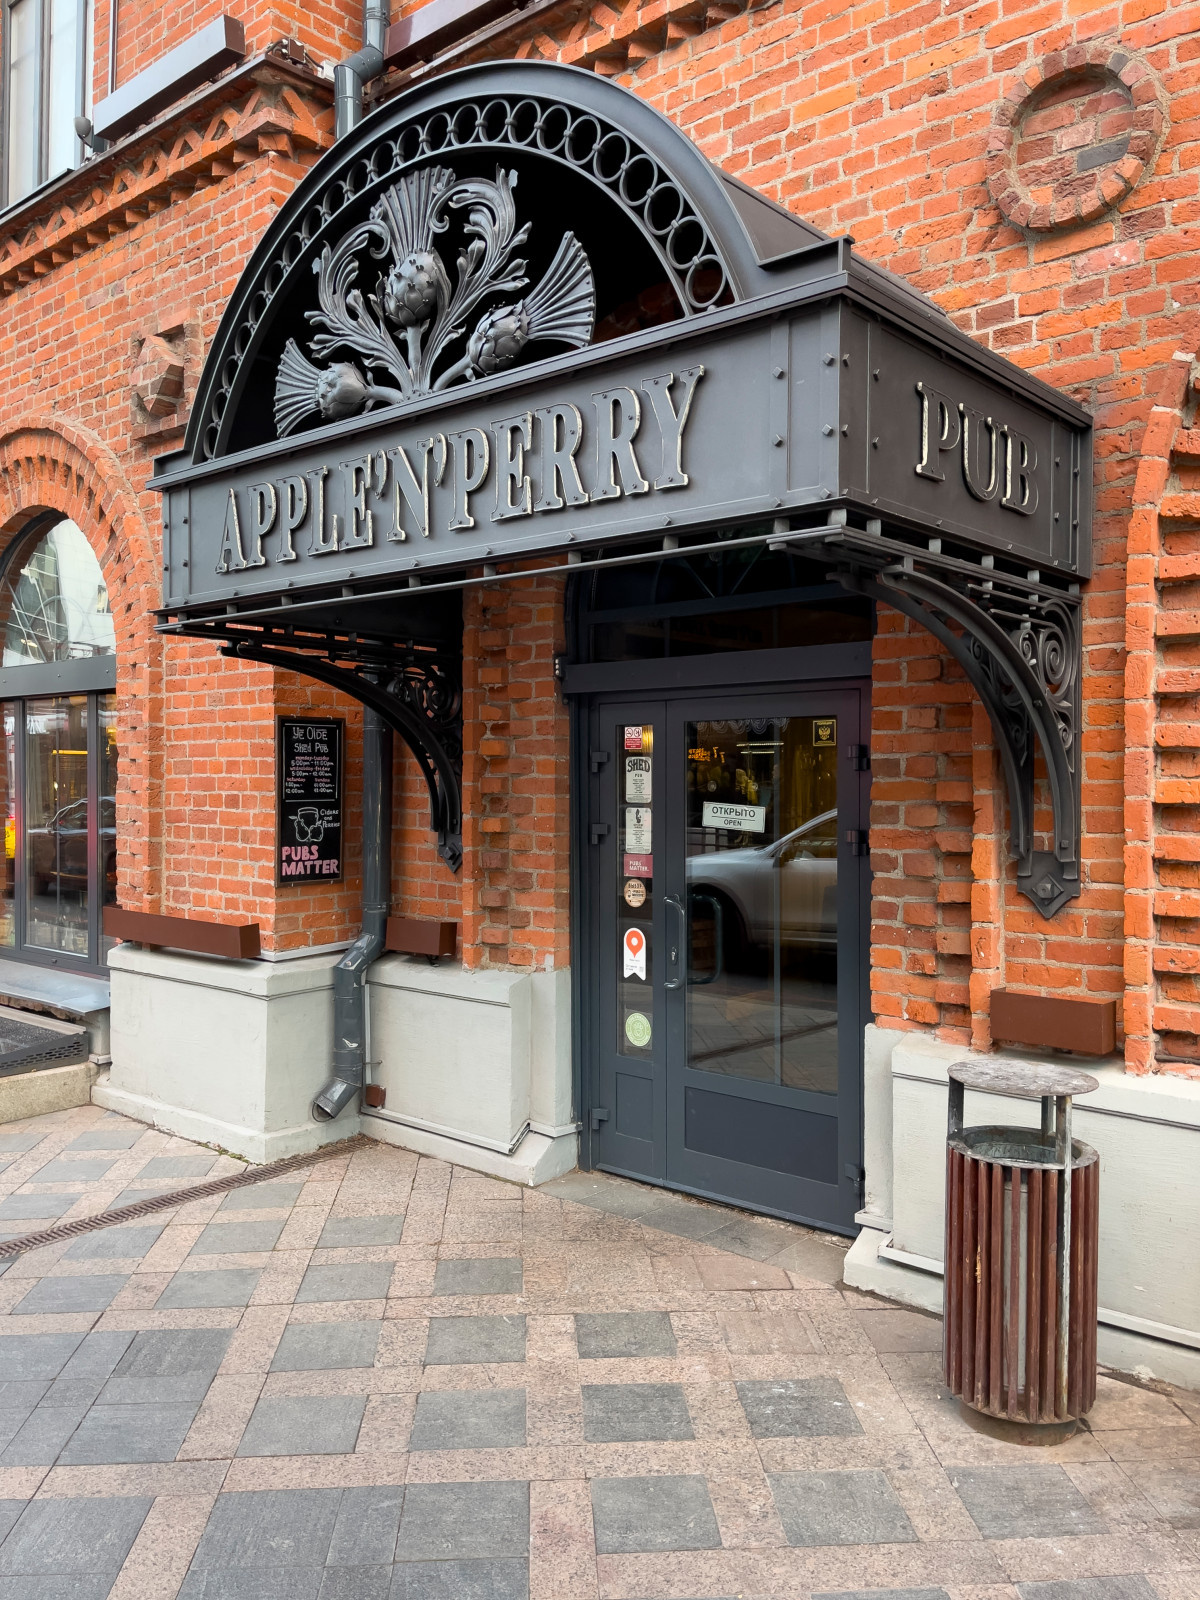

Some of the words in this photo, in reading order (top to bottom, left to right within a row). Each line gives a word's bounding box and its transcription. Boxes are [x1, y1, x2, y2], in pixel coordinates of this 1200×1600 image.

[915, 381, 1039, 515] PUB
[214, 364, 705, 574] APPLE'N'PERRY
[627, 758, 651, 773] SHED
[711, 806, 756, 819] ОТКРЫТО
[723, 818, 742, 827] OPEN
[281, 845, 319, 861] PUBS
[281, 859, 340, 876] MATTER
